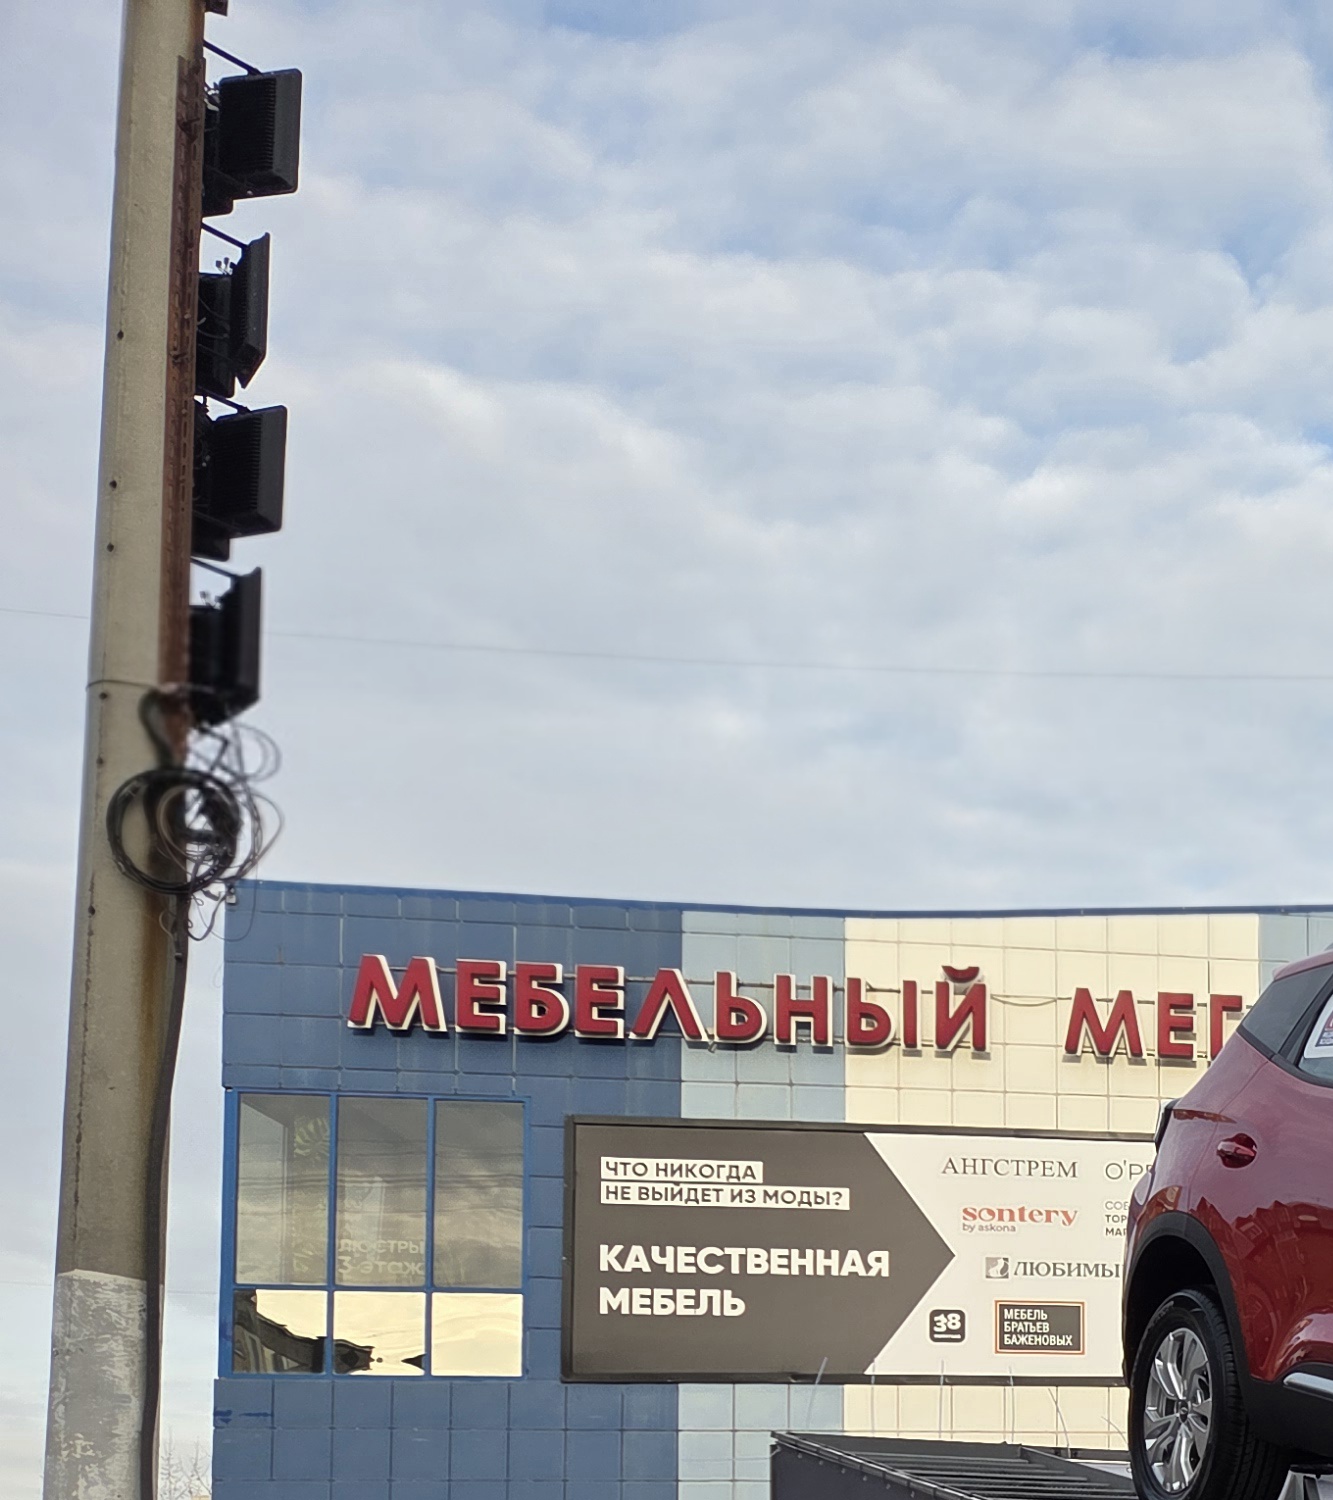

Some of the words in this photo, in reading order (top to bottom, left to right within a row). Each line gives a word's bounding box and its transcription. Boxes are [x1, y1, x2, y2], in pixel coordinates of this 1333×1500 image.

[347, 954, 990, 1054] МЕБЕЛЬНЫЙ
[605, 1161, 648, 1179] ЧТО
[655, 1163, 757, 1182] НИКОГДА
[941, 1157, 1078, 1178] АНГСТРЕМ
[605, 1186, 633, 1202] НЕ
[637, 1184, 726, 1205] ВЫЙДЕТ
[729, 1188, 757, 1204] ИЗ
[762, 1189, 843, 1207] МОДЫ?
[962, 1206, 1078, 1227] sontery
[962, 1223, 976, 1233] by
[978, 1224, 1016, 1232] askona
[599, 1245, 889, 1277] КАЧЕСТВЕННАЯ
[1014, 1261, 1124, 1279] ЛЮБИМЫ
[599, 1287, 745, 1317] МЕБЕЛЬ
[1004, 1308, 1048, 1320] МЕБЕЛЬ
[1004, 1321, 1050, 1333] БРАТЬЕВ
[1004, 1334, 1073, 1346] БАЖЕНОВЫХ
